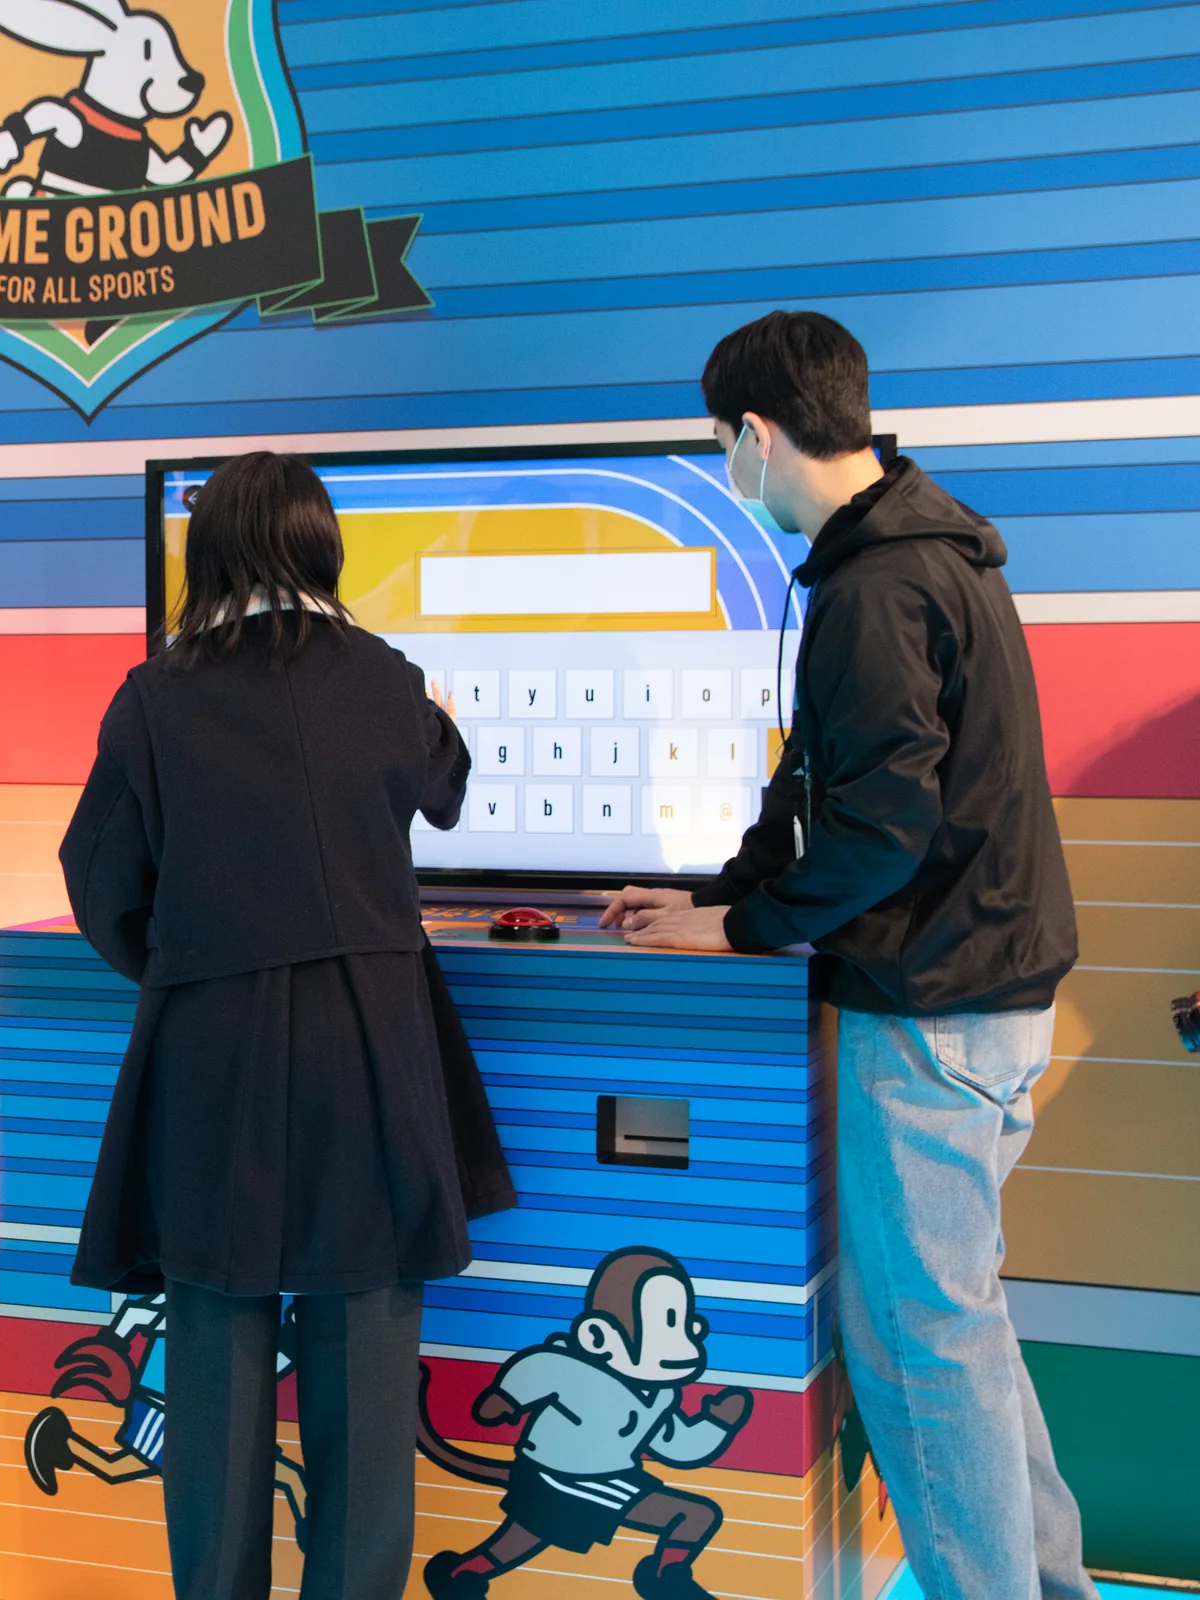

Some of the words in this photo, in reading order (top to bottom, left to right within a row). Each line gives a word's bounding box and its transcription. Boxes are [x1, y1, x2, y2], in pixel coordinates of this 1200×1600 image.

[64, 180, 266, 264] GROUND
[42, 275, 82, 304] ALL
[88, 265, 175, 303] SPORTS
[473, 685, 481, 703] t
[528, 688, 538, 706] y
[584, 688, 595, 703] u
[645, 684, 651, 702] i
[702, 688, 712, 703] o
[761, 688, 771, 707] p
[497, 745, 508, 764] g
[552, 741, 563, 760] h
[611, 741, 619, 765] j
[669, 742, 679, 761] k
[487, 802, 497, 817] v
[543, 798, 554, 817] b
[601, 803, 613, 818] n
[658, 803, 675, 819] m
[719, 802, 733, 822] @
